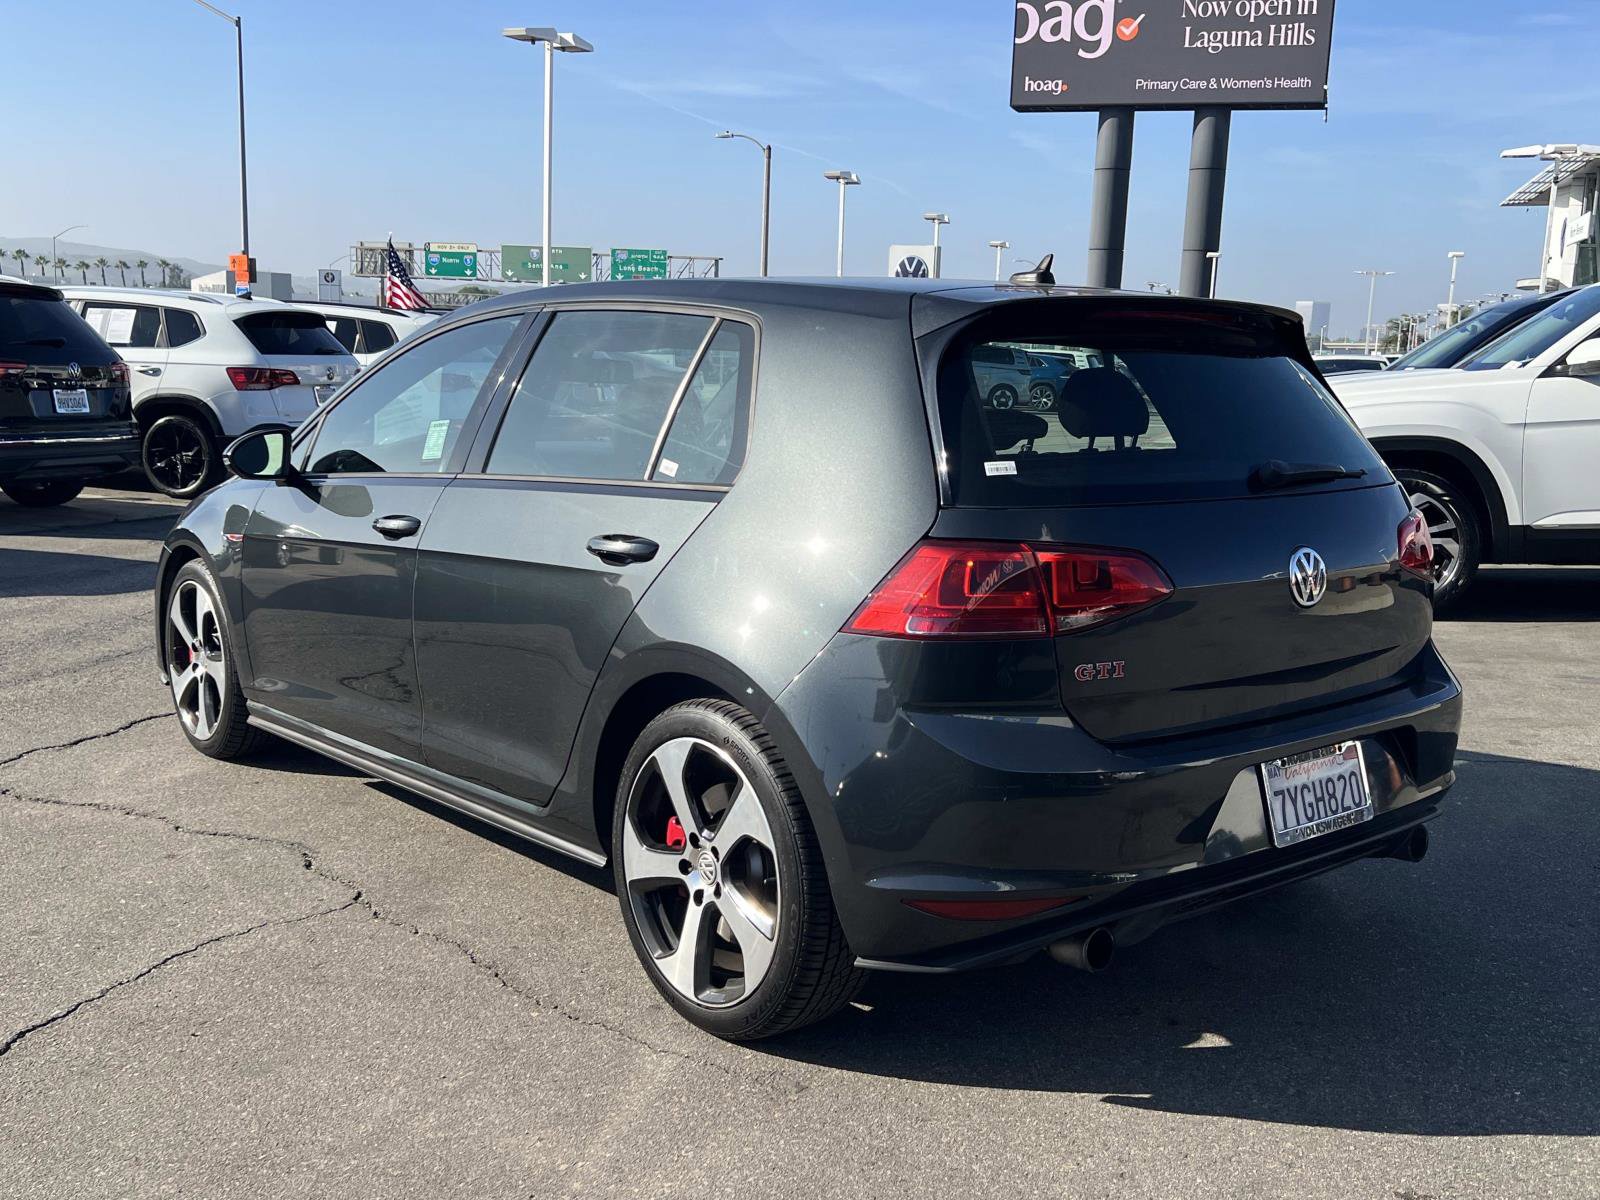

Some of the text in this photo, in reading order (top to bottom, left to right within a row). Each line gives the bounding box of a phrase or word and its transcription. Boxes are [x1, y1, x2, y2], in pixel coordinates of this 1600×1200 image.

[1181, 0, 1318, 22] Now open in
[1184, 22, 1316, 54] Laguna Hills
[1135, 79, 1179, 92] Primary
[1180, 78, 1207, 90] Care
[1209, 78, 1218, 89] &
[1274, 77, 1312, 89] Health
[619, 264, 636, 272] Long
[1074, 660, 1126, 682] GTI
[1273, 770, 1362, 830] 7YGH820
